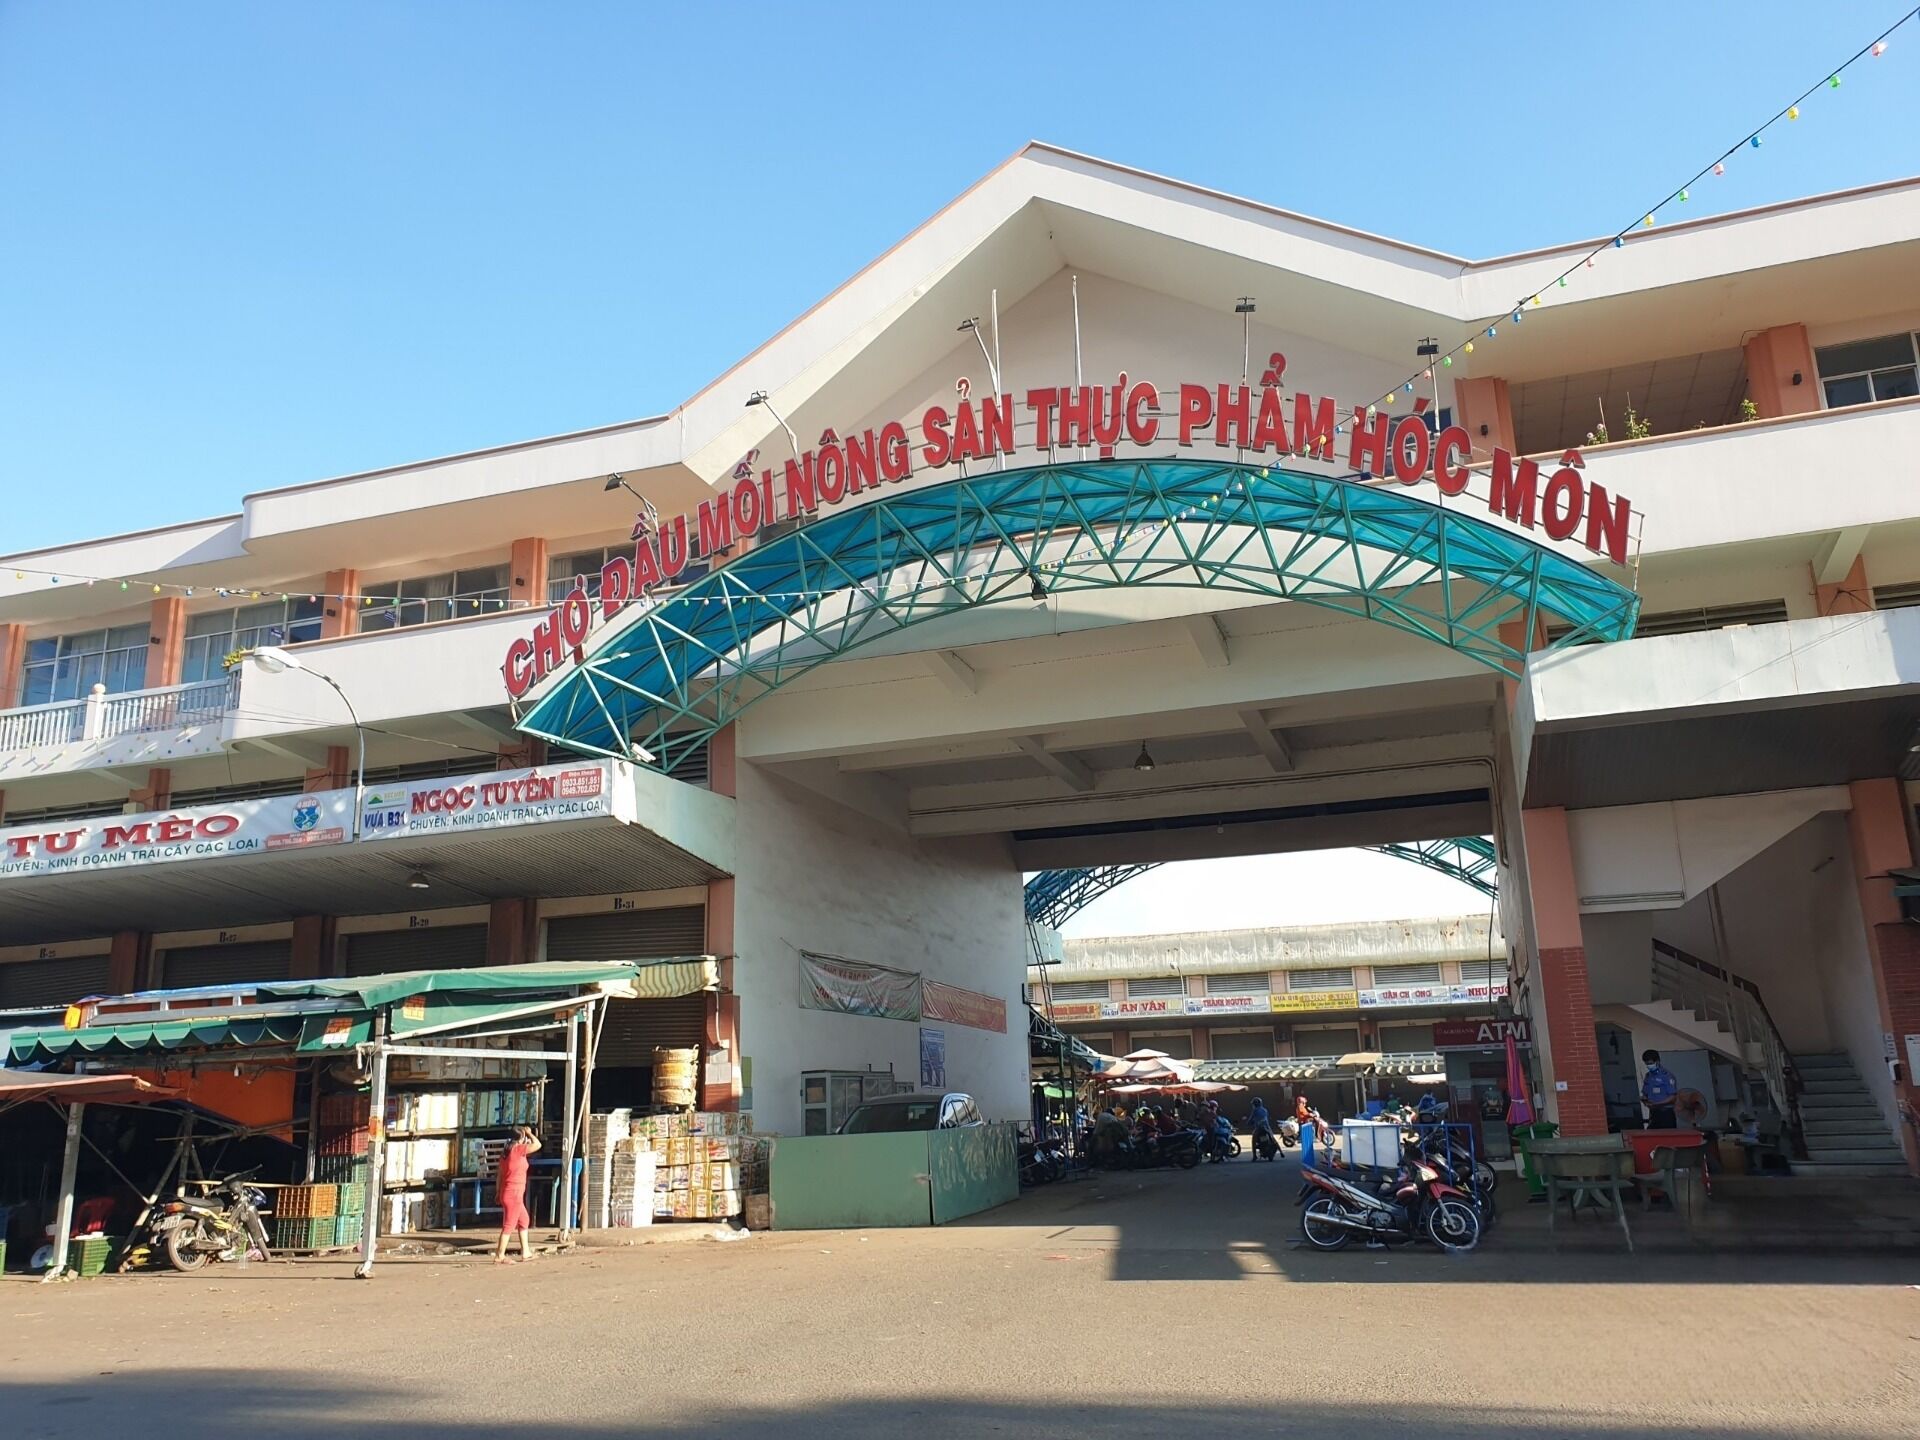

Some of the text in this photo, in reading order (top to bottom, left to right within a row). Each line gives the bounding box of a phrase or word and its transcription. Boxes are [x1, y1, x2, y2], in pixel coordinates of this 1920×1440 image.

[503, 352, 1631, 699] CHỢ ĐẦU MỐI NÔNG SẢN THỰC PHẨM HÓC MÔN
[411, 786, 475, 814] NGỌC
[453, 813, 474, 826] KINH
[476, 811, 509, 824] DOANH
[558, 801, 577, 814] CÁC
[0, 860, 44, 873] HUYÊN:
[48, 856, 78, 869] KINH
[82, 851, 126, 865] DOANH
[131, 846, 160, 860] TRÁI
[164, 844, 191, 858] CÂY
[228, 838, 258, 851] LOẠI
[7, 827, 87, 857] TƯ
[1476, 1021, 1527, 1041] ATM
